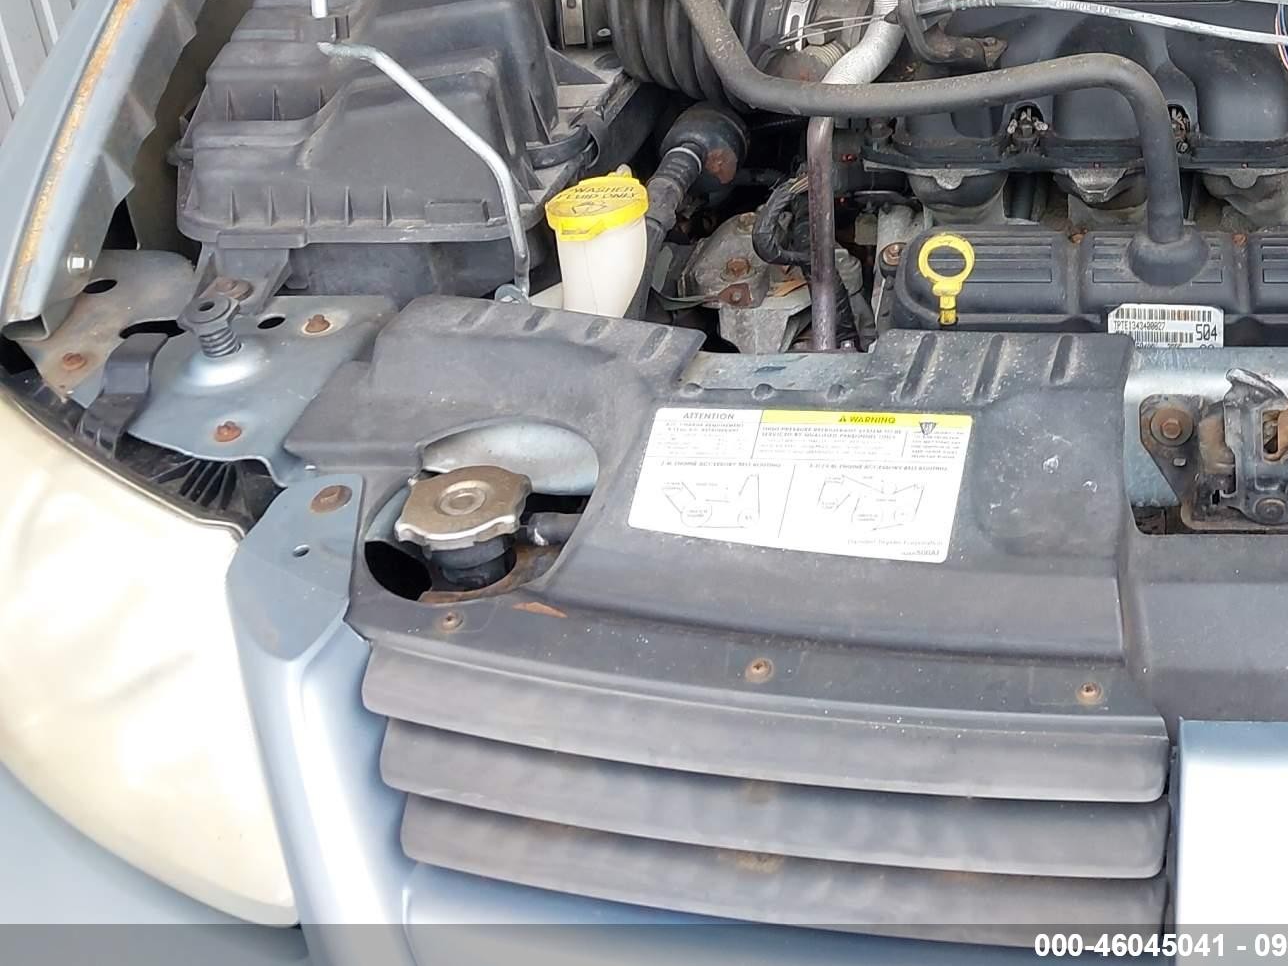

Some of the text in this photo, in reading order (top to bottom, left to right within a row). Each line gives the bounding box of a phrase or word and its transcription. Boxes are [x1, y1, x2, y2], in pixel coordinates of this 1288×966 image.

[557, 192, 599, 200] FLUID
[1195, 323, 1218, 341] 504
[683, 412, 735, 420] ATTENTION
[849, 416, 897, 424] WARNING
